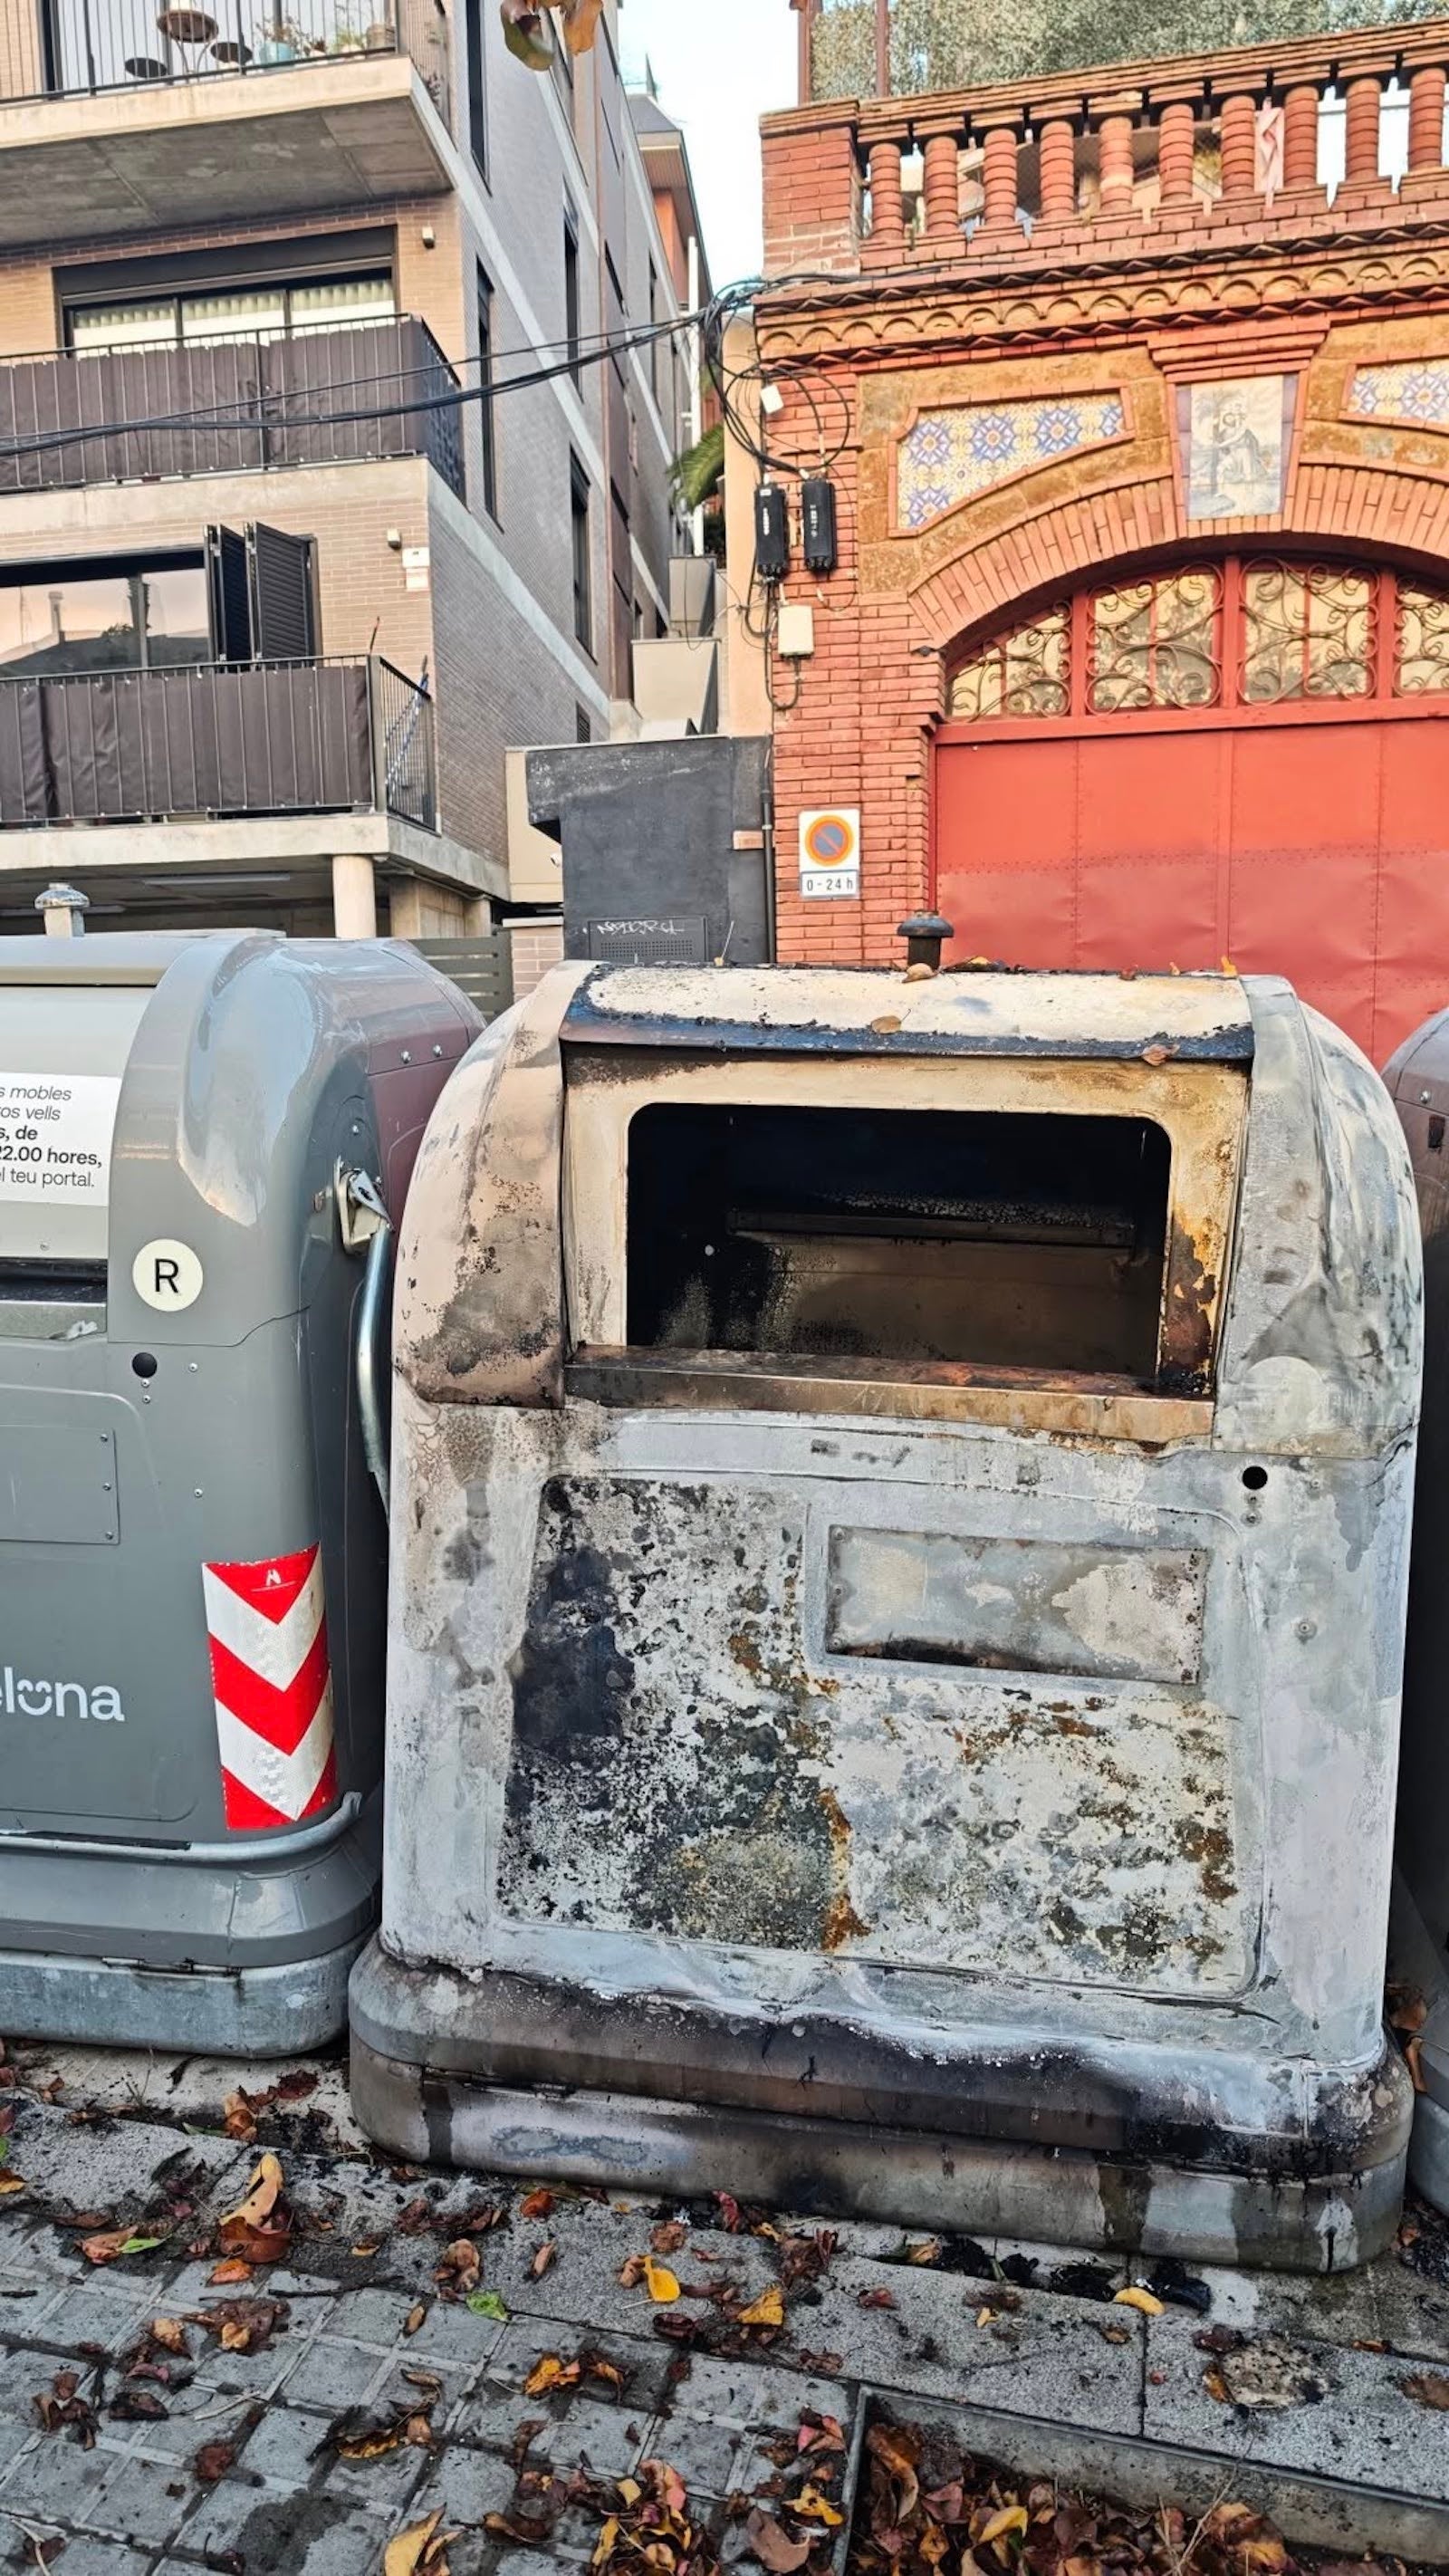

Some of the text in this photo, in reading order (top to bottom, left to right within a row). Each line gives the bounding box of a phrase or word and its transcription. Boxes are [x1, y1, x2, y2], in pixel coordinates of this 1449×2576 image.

[826, 879, 841, 890] 24
[9, 1085, 72, 1101] mobles
[25, 1105, 61, 1120] vells
[15, 1124, 38, 1139] de
[0, 1146, 101, 1168] 2.00 hores,
[10, 1168, 36, 1184] teu
[43, 1171, 94, 1188] portal.
[154, 1258, 179, 1293] R
[0, 1667, 125, 1722] lona
